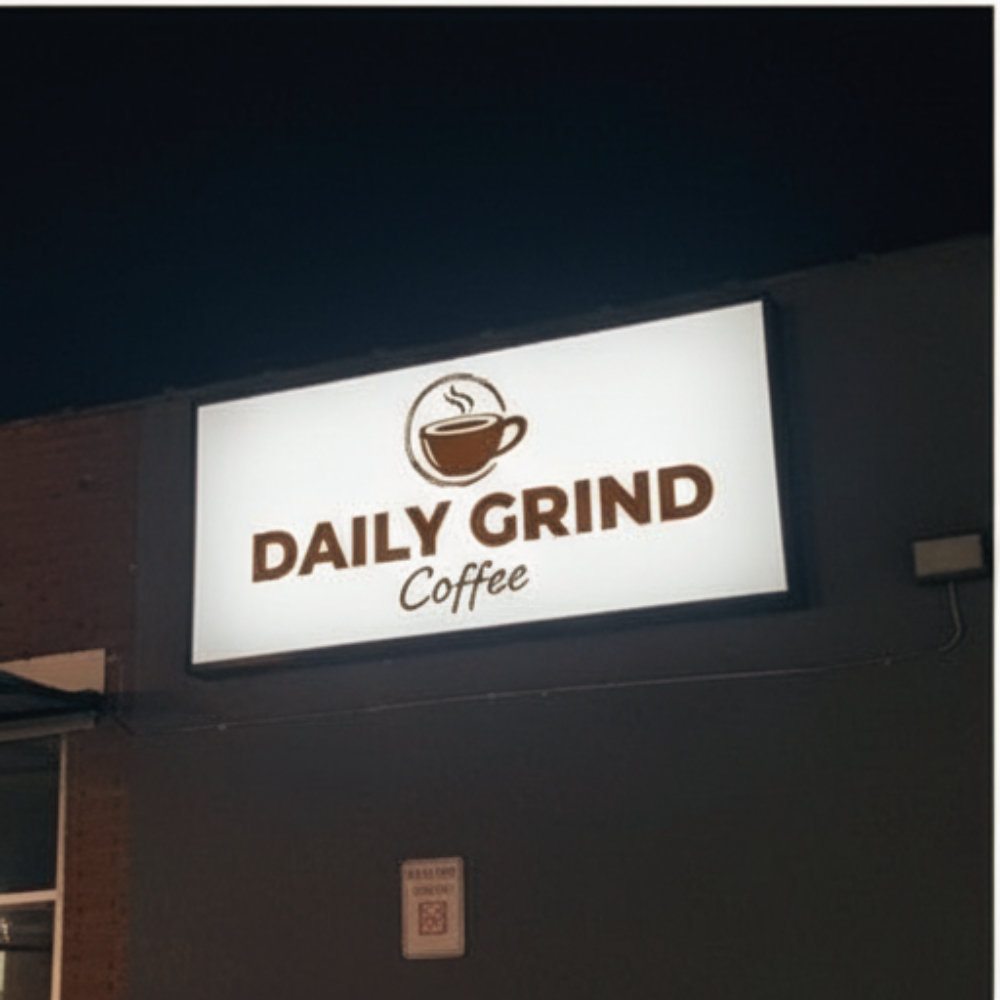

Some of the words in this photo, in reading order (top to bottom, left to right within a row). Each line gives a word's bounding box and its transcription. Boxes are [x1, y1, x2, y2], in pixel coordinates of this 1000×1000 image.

[251, 500, 452, 583] DAILY
[469, 463, 715, 548] GRIND
[399, 559, 530, 615] Coffee
